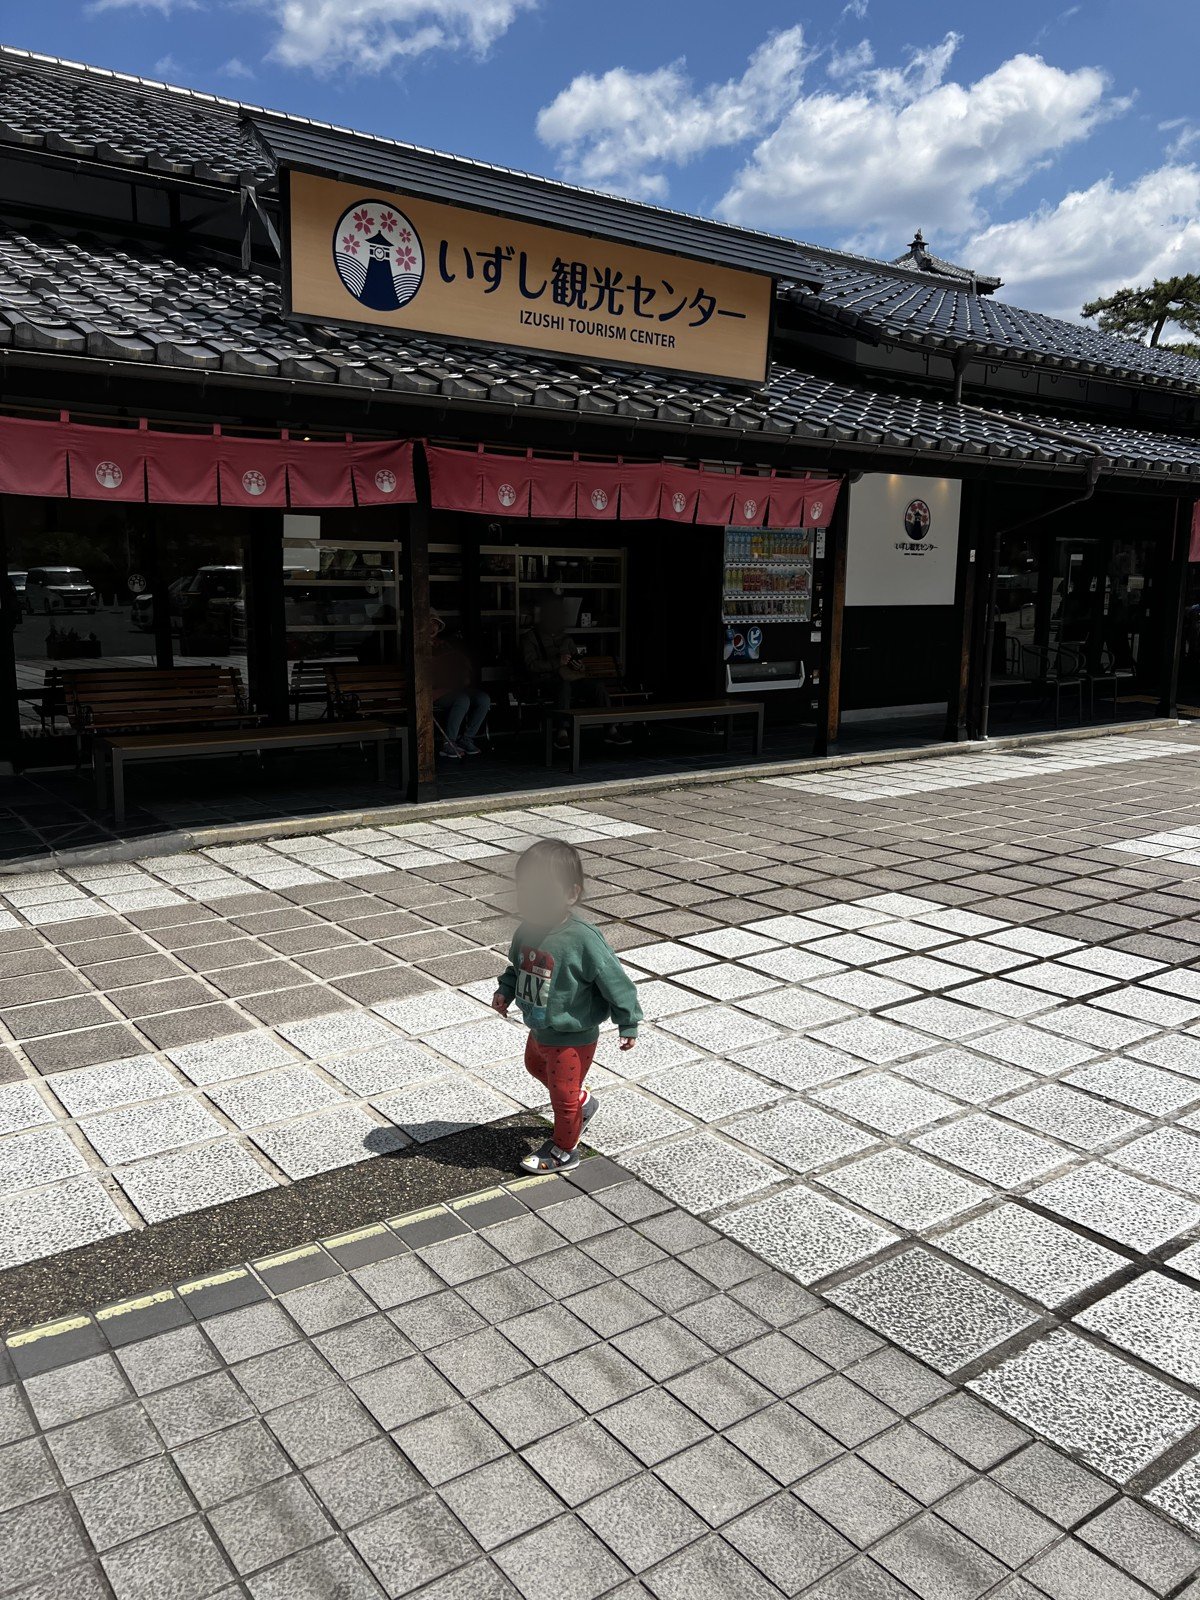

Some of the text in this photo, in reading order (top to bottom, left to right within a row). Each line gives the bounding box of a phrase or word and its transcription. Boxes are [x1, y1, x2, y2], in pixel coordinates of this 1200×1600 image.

[439, 240, 747, 327] いずし観光センター
[520, 310, 675, 348] IZUSHI TOURISM CENTER
